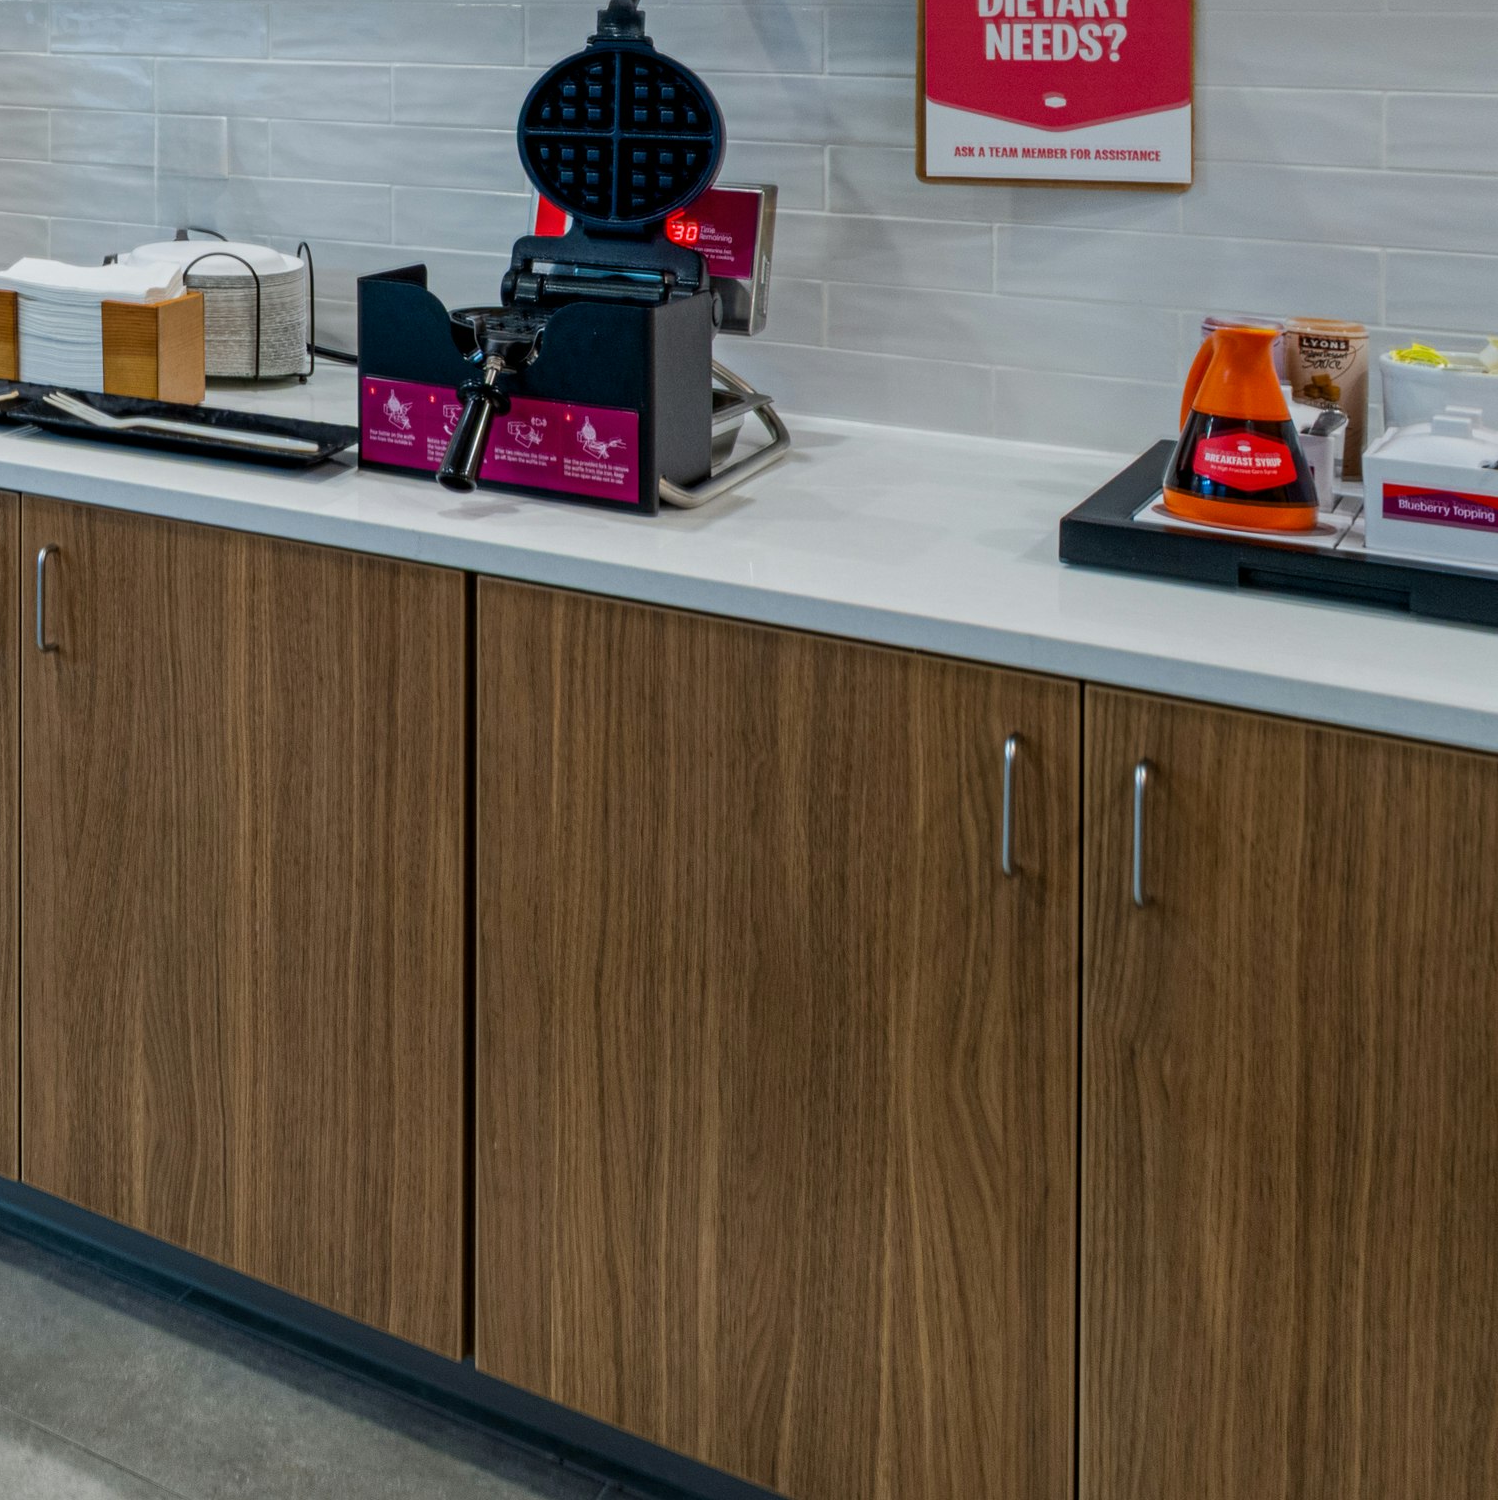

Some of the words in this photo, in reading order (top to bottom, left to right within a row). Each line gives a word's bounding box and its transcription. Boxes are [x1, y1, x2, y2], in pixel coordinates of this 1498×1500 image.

[985, 23, 1127, 62] NEEDS?
[954, 146, 975, 158] ASK
[978, 147, 986, 158] A
[988, 147, 1018, 159] TEAM
[1022, 148, 1068, 160] MEMBER
[1070, 149, 1091, 160] FOR
[1094, 150, 1161, 162] ASSISTANCE
[700, 225, 716, 234] Time
[699, 233, 732, 244] Remaining
[1303, 338, 1346, 350] LYONS
[1302, 355, 1342, 370] Sauce
[1205, 452, 1252, 466] BREAKFAST
[1254, 457, 1282, 468] SYRUP
[1398, 500, 1450, 516] Blueberry
[1453, 506, 1496, 522] Topping
